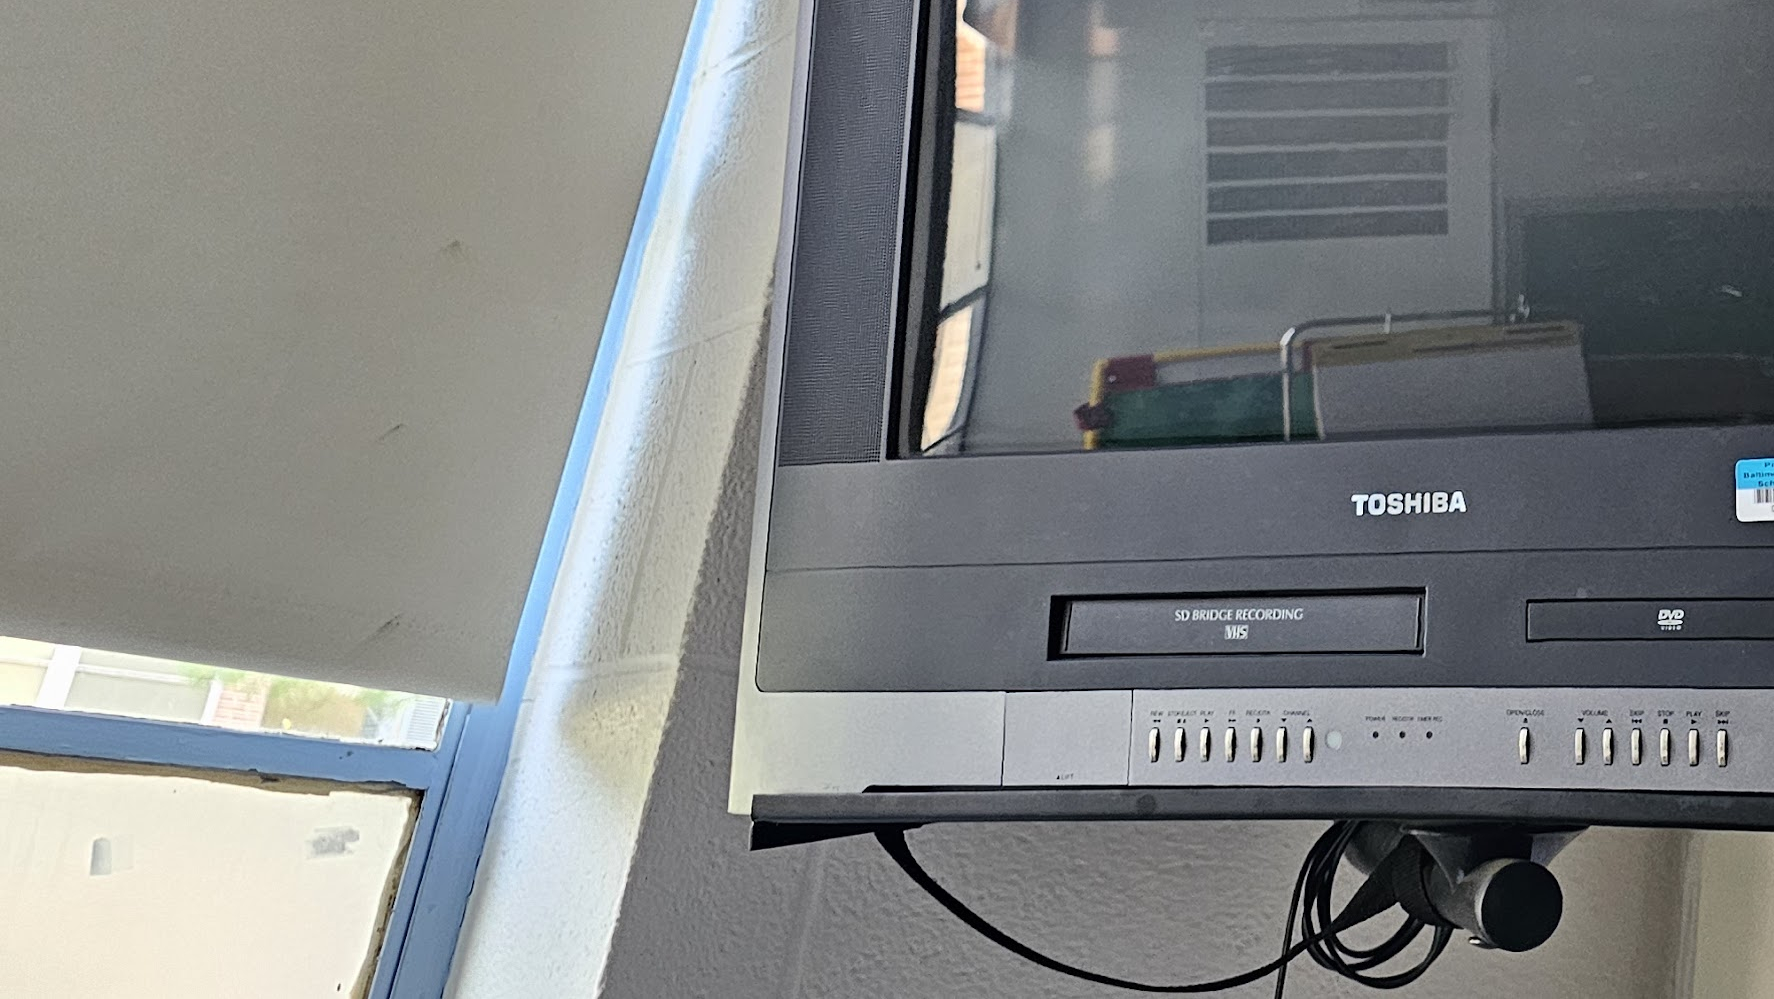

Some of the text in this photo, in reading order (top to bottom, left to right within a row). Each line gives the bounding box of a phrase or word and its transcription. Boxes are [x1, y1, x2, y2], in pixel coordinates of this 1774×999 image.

[1351, 491, 1467, 516] TOSHIBA
[1174, 607, 1304, 622] SD BRIDGE RECORDING
[1658, 609, 1684, 620] DVD
[1224, 625, 1249, 640] VHS
